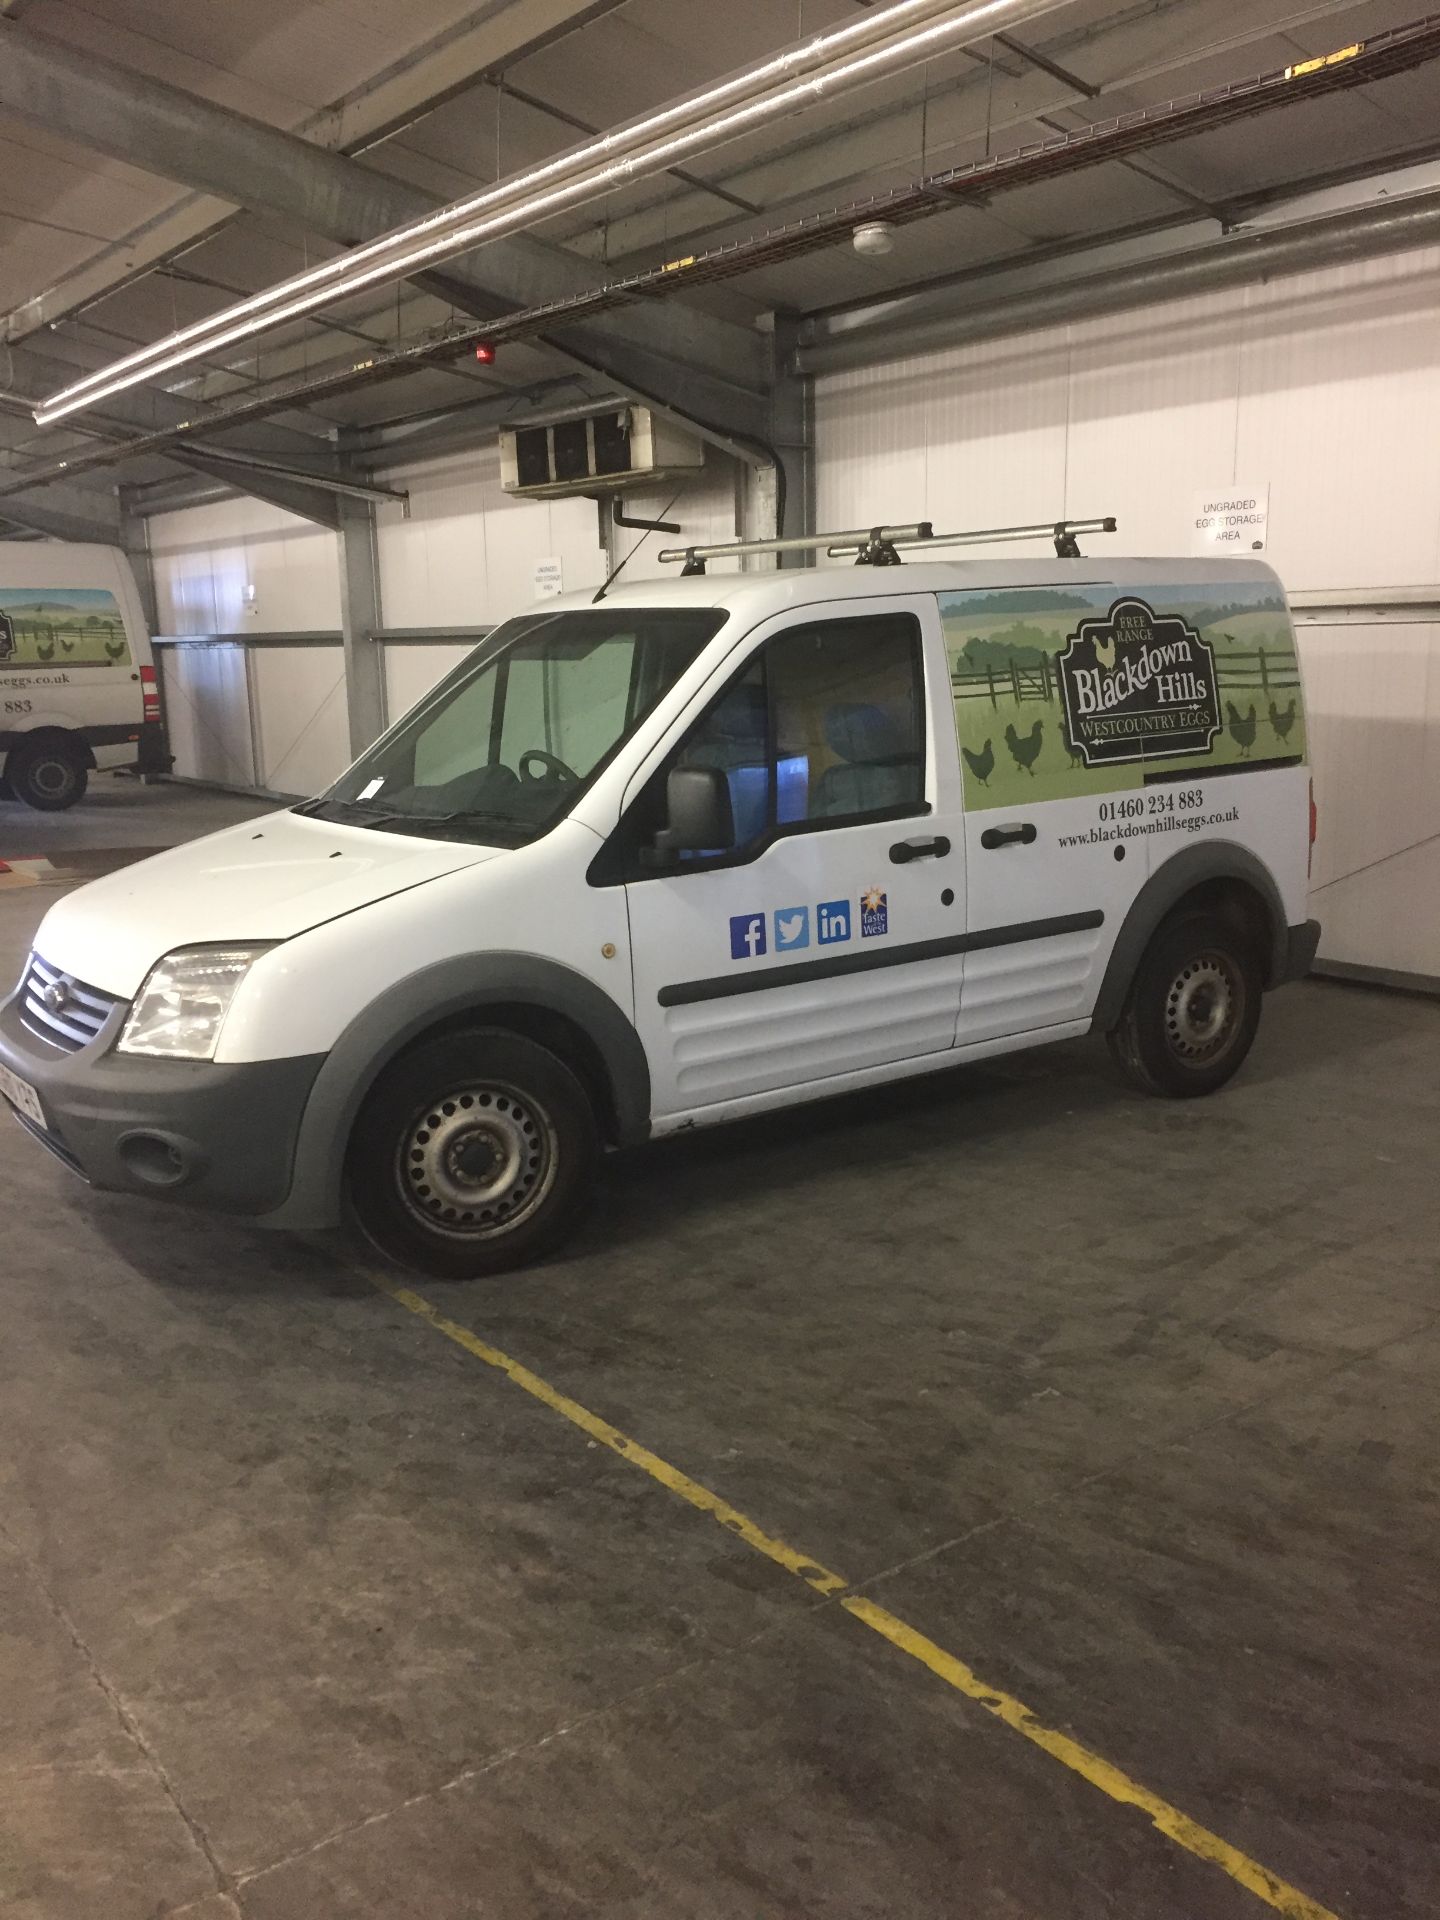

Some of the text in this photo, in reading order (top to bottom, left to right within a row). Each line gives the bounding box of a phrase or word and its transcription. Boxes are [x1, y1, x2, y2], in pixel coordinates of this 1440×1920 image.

[1203, 499, 1257, 513] UNGRADED
[1196, 513, 1264, 528] EGG STORAGE
[1215, 531, 1241, 541] AREA
[1120, 615, 1147, 629] FREE
[1116, 628, 1154, 642] RANGE
[1072, 640, 1193, 714] Blackdown
[1155, 672, 1208, 703] Hills
[4, 699, 33, 713] 883
[1080, 710, 1211, 737] WESTCOUNTRY EGGS
[1099, 789, 1204, 821] 01460 234 883
[1058, 806, 1240, 848] www.blackdownhillseggs.co.uk
[820, 908, 847, 938] in
[863, 912, 886, 924] Taste
[863, 923, 886, 935] West
